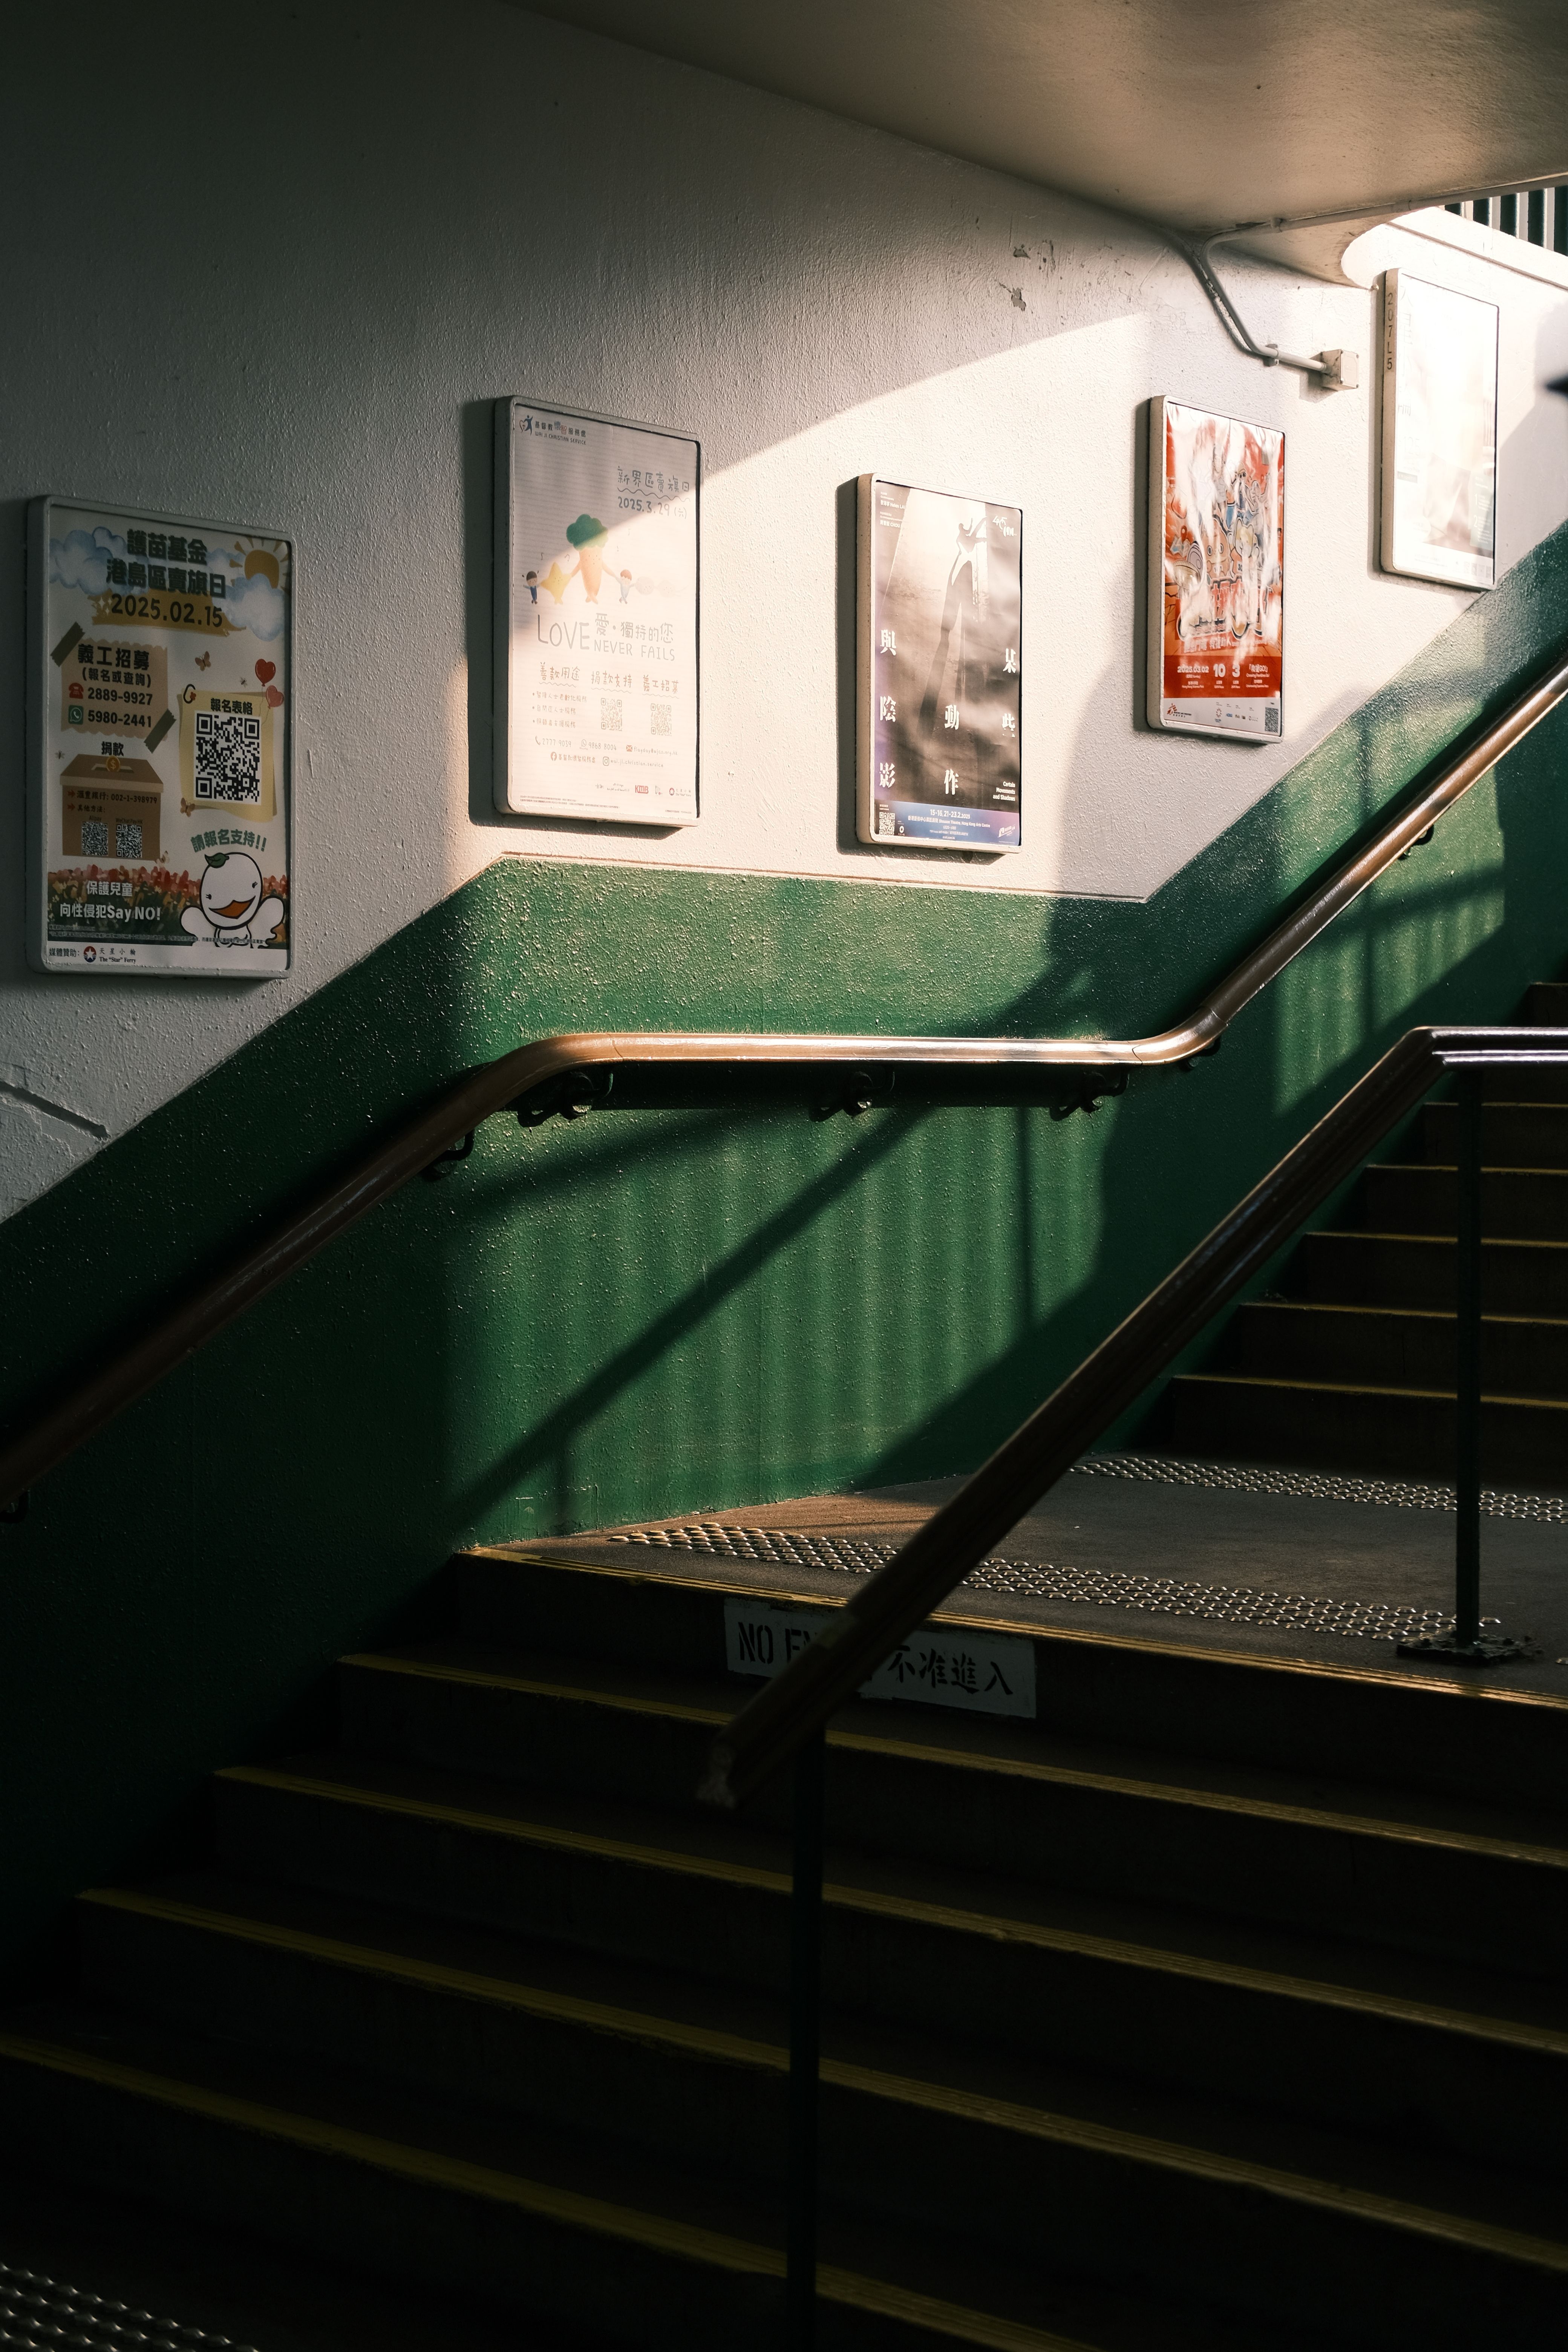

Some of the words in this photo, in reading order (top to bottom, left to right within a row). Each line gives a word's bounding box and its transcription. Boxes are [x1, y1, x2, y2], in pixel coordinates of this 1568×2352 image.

[617, 465, 689, 493] 新界區賣旗日
[617, 496, 670, 516] 2025.3.29
[674, 507, 687, 520] (六)
[127, 528, 208, 565] 護苗基金
[106, 558, 226, 599] 港島區賣旗日
[111, 593, 223, 628] 2025.02.15
[537, 613, 590, 650] LOVE
[78, 643, 149, 671] 義工招募
[594, 640, 633, 657] NEVER
[641, 645, 675, 662] FAILS
[82, 667, 152, 688] (報名或查詢)
[539, 661, 580, 681] 善款用途
[591, 669, 632, 688] 捐款支持
[1213, 663, 1226, 677] 10
[1232, 665, 1240, 677] 3
[642, 674, 679, 694] 義工招募
[88, 687, 153, 706] 2889-9927
[210, 698, 253, 715] 報名表格
[88, 709, 152, 728] 5980-2441
[101, 741, 124, 756] 捐款
[558, 740, 572, 748] 9039
[588, 741, 601, 750] 9868
[111, 793, 157, 804] 002-1-398979
[635, 785, 649, 794] KMB
[190, 828, 267, 853] 請報名支持!!
[86, 880, 133, 898] 保護兒童
[135, 907, 161, 921] NO!
[49, 948, 80, 957] 媒體贊助:
[100, 947, 136, 956] 天星小輪
[738, 1621, 774, 1665] NO
[888, 1644, 1014, 1695] 不准進入
